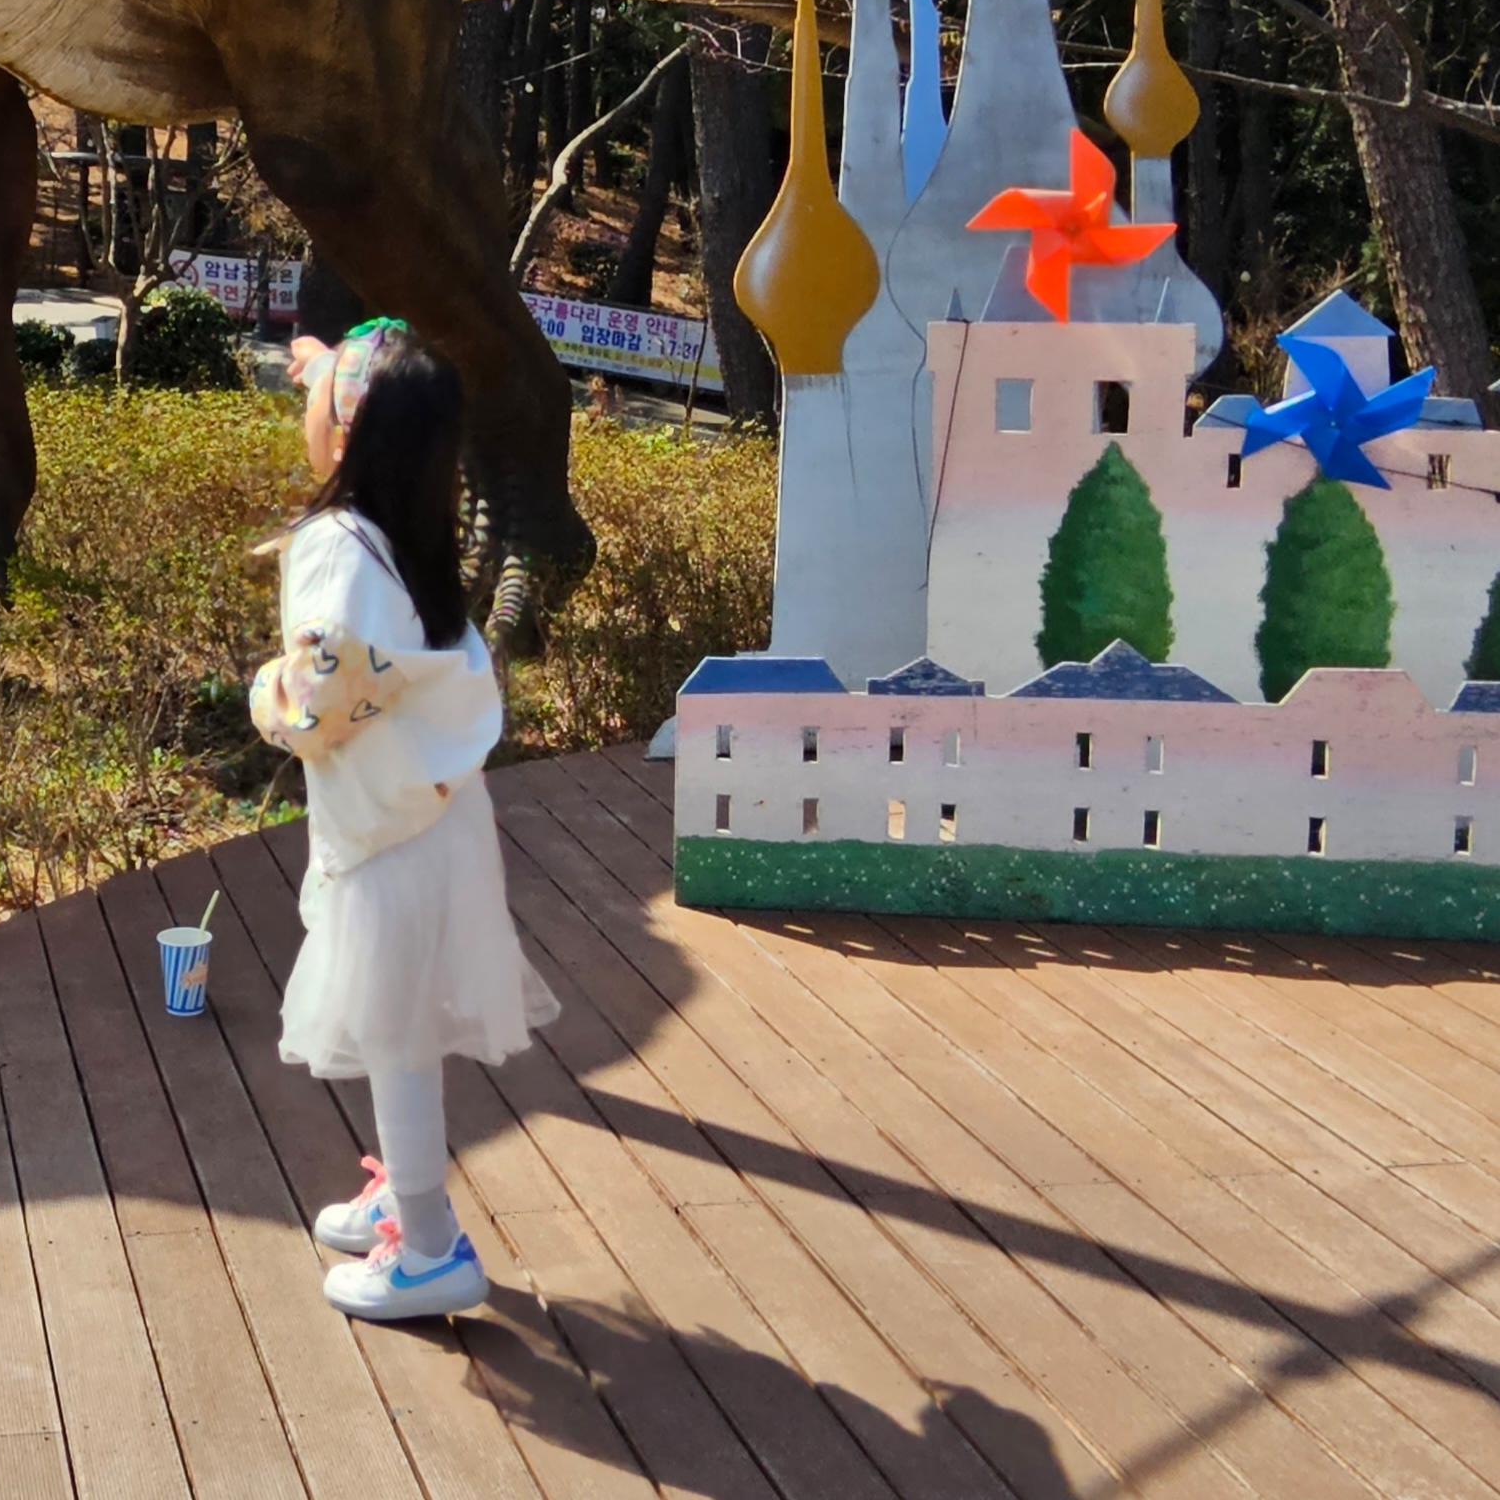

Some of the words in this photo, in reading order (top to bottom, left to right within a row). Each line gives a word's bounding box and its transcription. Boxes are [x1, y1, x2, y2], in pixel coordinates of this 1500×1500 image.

[581, 324, 643, 352] 입장마감
[607, 309, 640, 333] 운영
[645, 316, 679, 339] 안내
